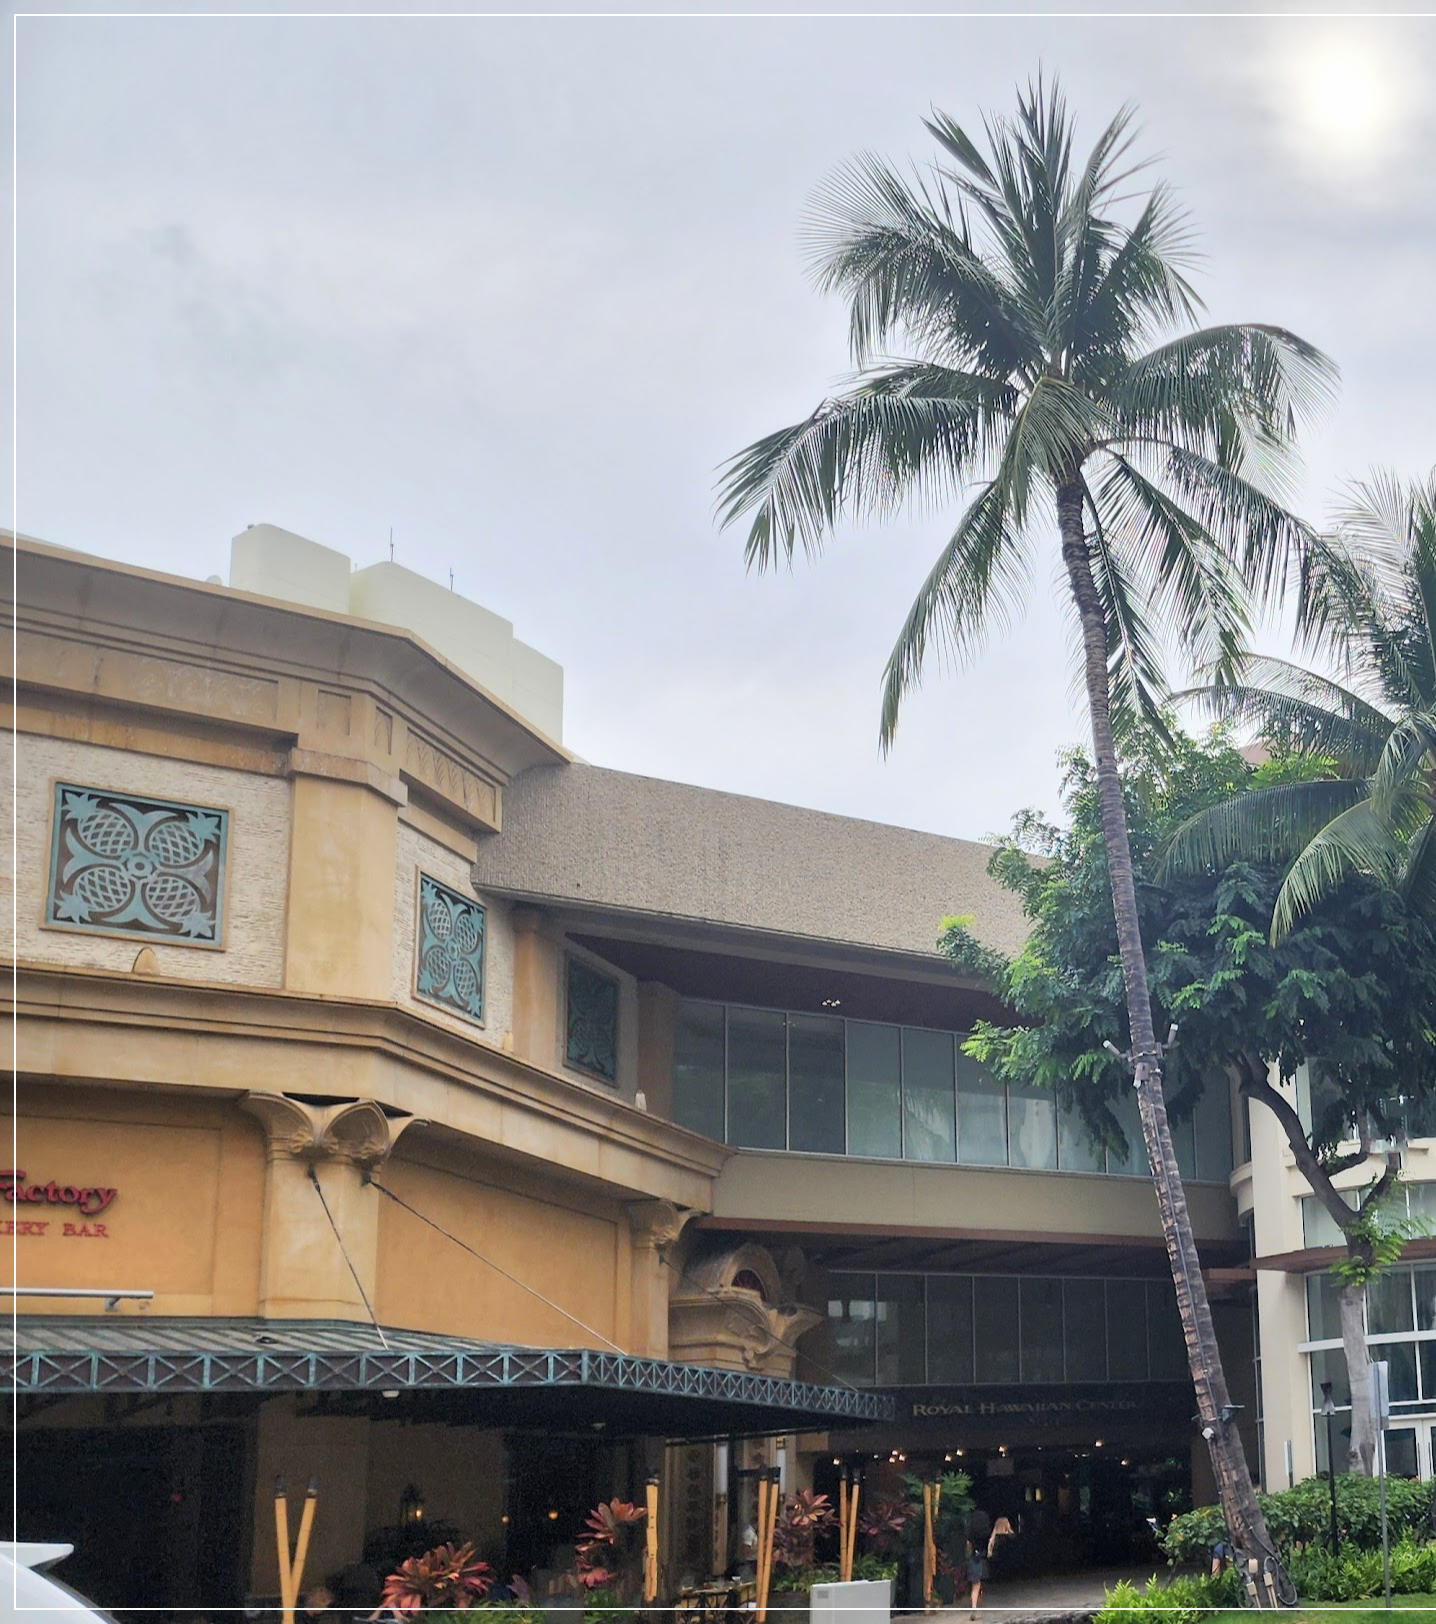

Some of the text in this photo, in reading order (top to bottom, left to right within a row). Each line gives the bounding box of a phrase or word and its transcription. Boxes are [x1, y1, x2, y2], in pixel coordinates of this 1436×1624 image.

[0, 1221, 109, 1238] ERY BAR
[912, 1404, 970, 1416] ROYAL
